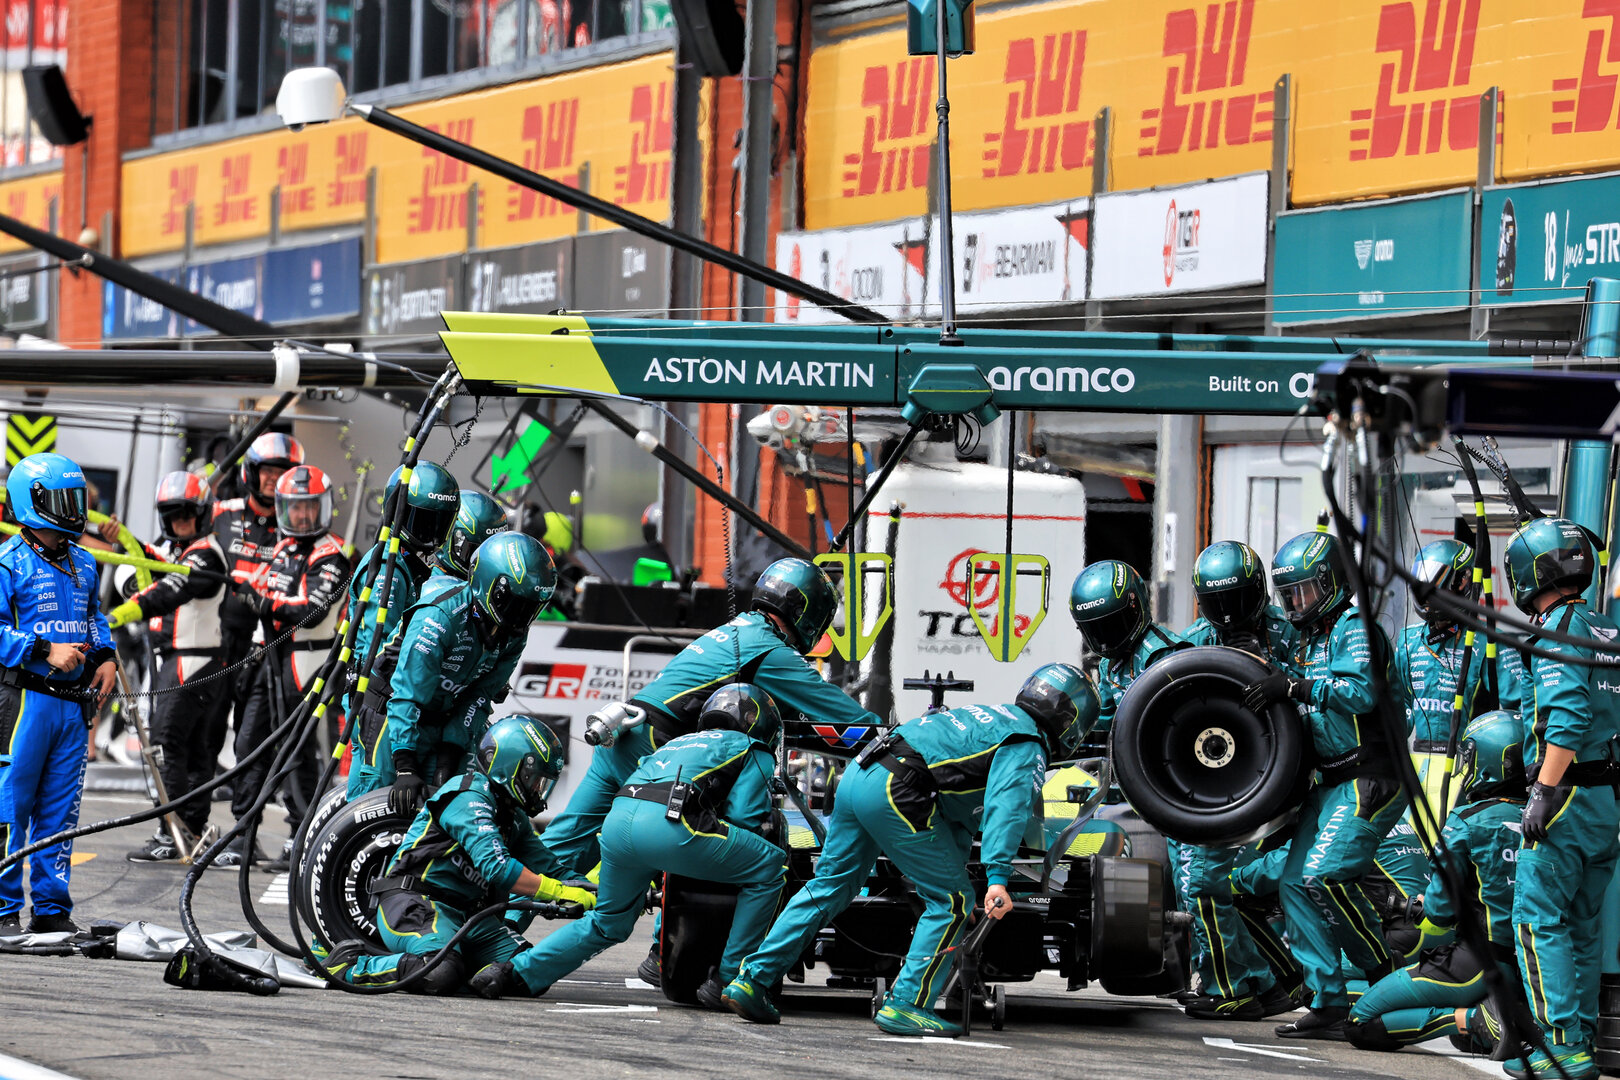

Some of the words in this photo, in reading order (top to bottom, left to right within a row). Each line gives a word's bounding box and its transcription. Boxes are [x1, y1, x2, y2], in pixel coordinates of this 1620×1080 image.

[1138, 0, 1274, 157] DHL
[983, 29, 1095, 178] DHL
[994, 239, 1056, 278] BEARMAN
[1544, 211, 1557, 281] 18
[643, 357, 746, 384] ASTON
[755, 360, 874, 388] MARTIN
[988, 366, 1135, 393] aramco
[1209, 375, 1251, 392] Built
[1255, 379, 1279, 393] on
[428, 492, 457, 502] aramco
[1206, 576, 1238, 588] aramco
[38, 592, 56, 600] BOSS
[1076, 597, 1106, 611] aramco
[33, 620, 88, 634] aramco
[515, 674, 584, 699] GR
[1468, 715, 1498, 732] Valvoline
[525, 724, 547, 752] Valvoline
[70, 743, 89, 817] MARTIN
[353, 802, 396, 824] PIREL
[1306, 805, 1349, 869] MARTIN
